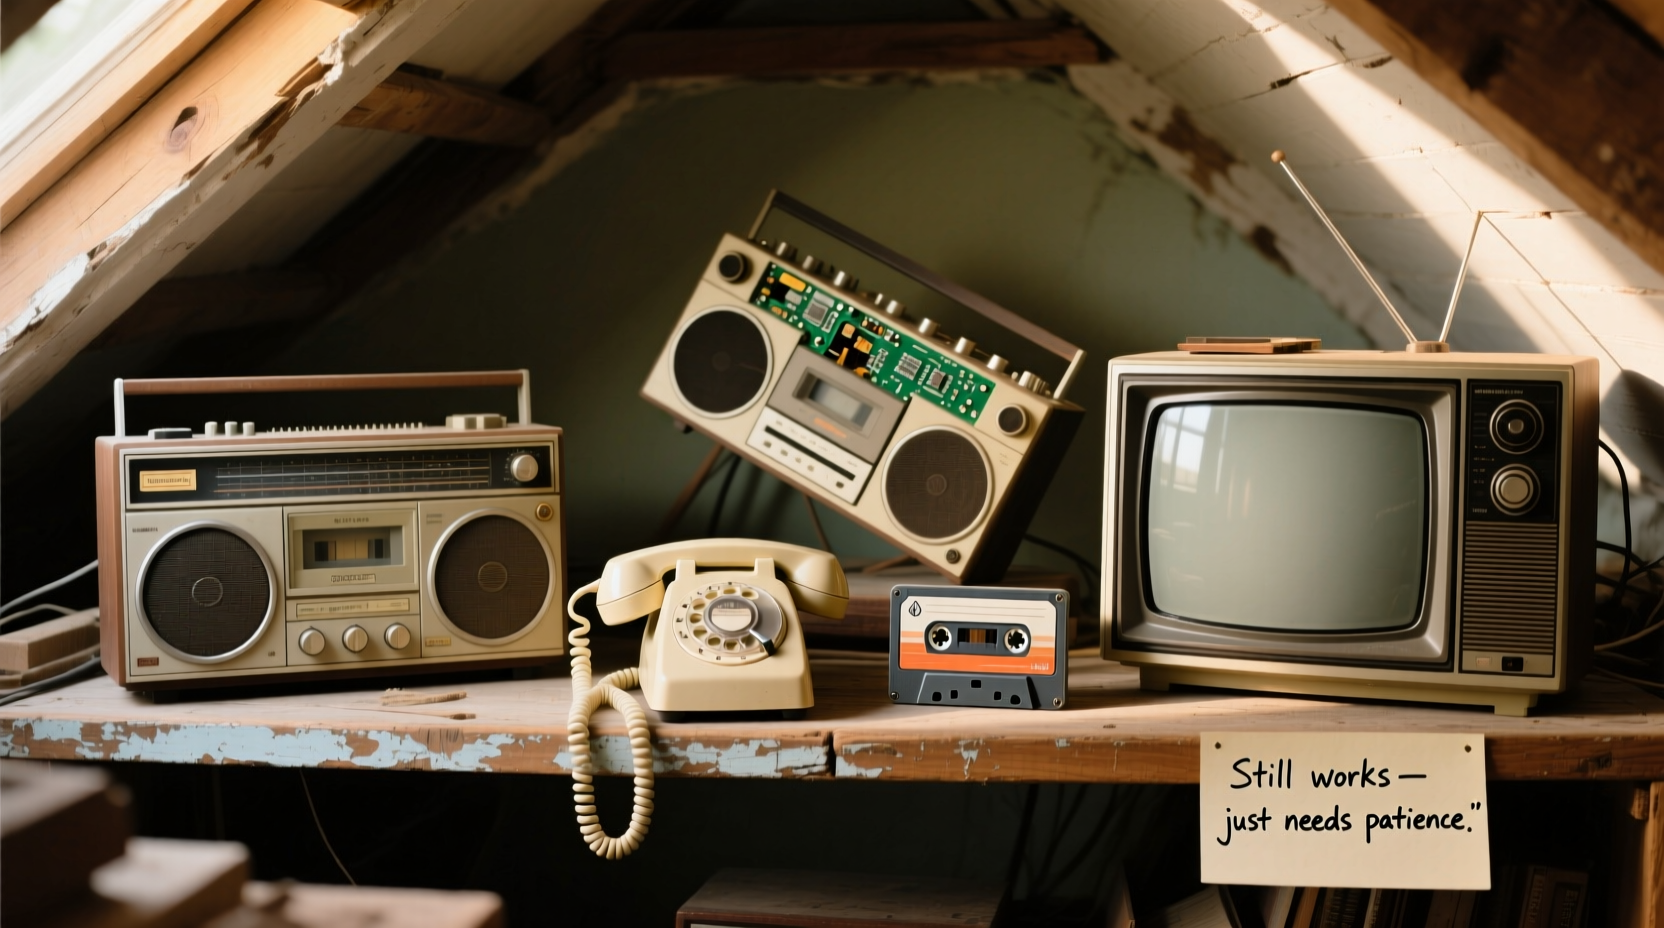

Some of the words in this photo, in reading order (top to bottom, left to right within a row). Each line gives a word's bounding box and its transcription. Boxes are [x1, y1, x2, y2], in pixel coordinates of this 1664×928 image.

[1230, 757, 1292, 789] Still
[1216, 806, 1272, 847] just
[1284, 804, 1353, 832] needs
[1365, 801, 1482, 844] patience."
